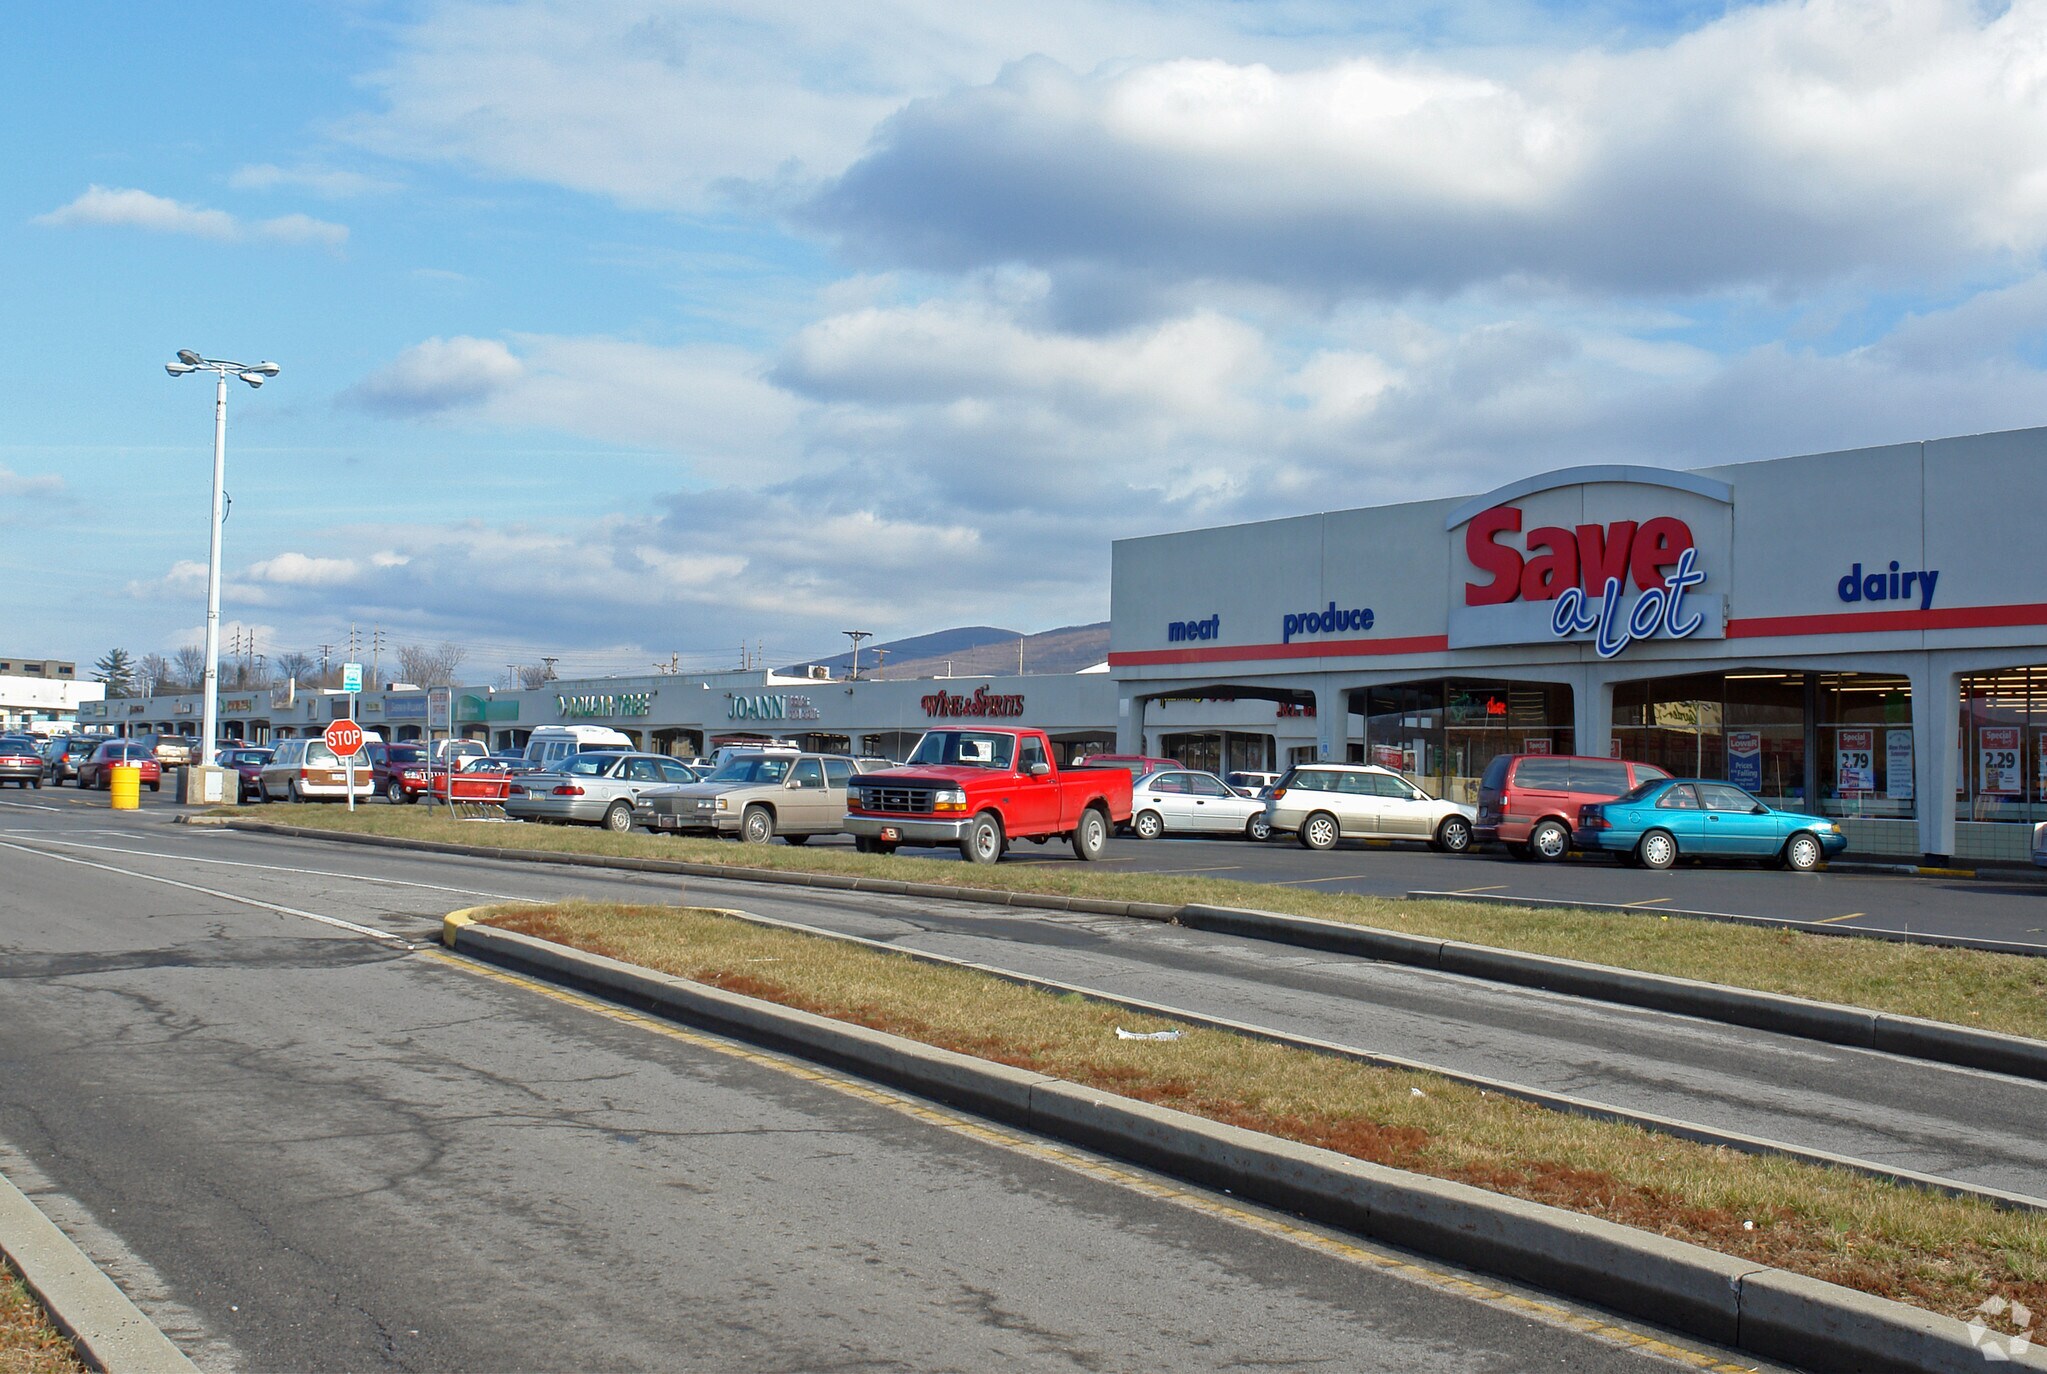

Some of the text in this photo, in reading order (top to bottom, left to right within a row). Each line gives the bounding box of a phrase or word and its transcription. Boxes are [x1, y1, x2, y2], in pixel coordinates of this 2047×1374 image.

[1465, 506, 1694, 606] Save
[1838, 560, 1939, 610] dairy
[1168, 613, 1220, 642] meat
[1283, 601, 1374, 644] produce
[971, 688, 1025, 717] SPIRITS
[327, 730, 361, 747] STOP
[1731, 739, 1758, 747] LOWER
[1843, 732, 1866, 743] Special
[1986, 730, 2012, 742] Special
[1985, 752, 2016, 769] 2.29
